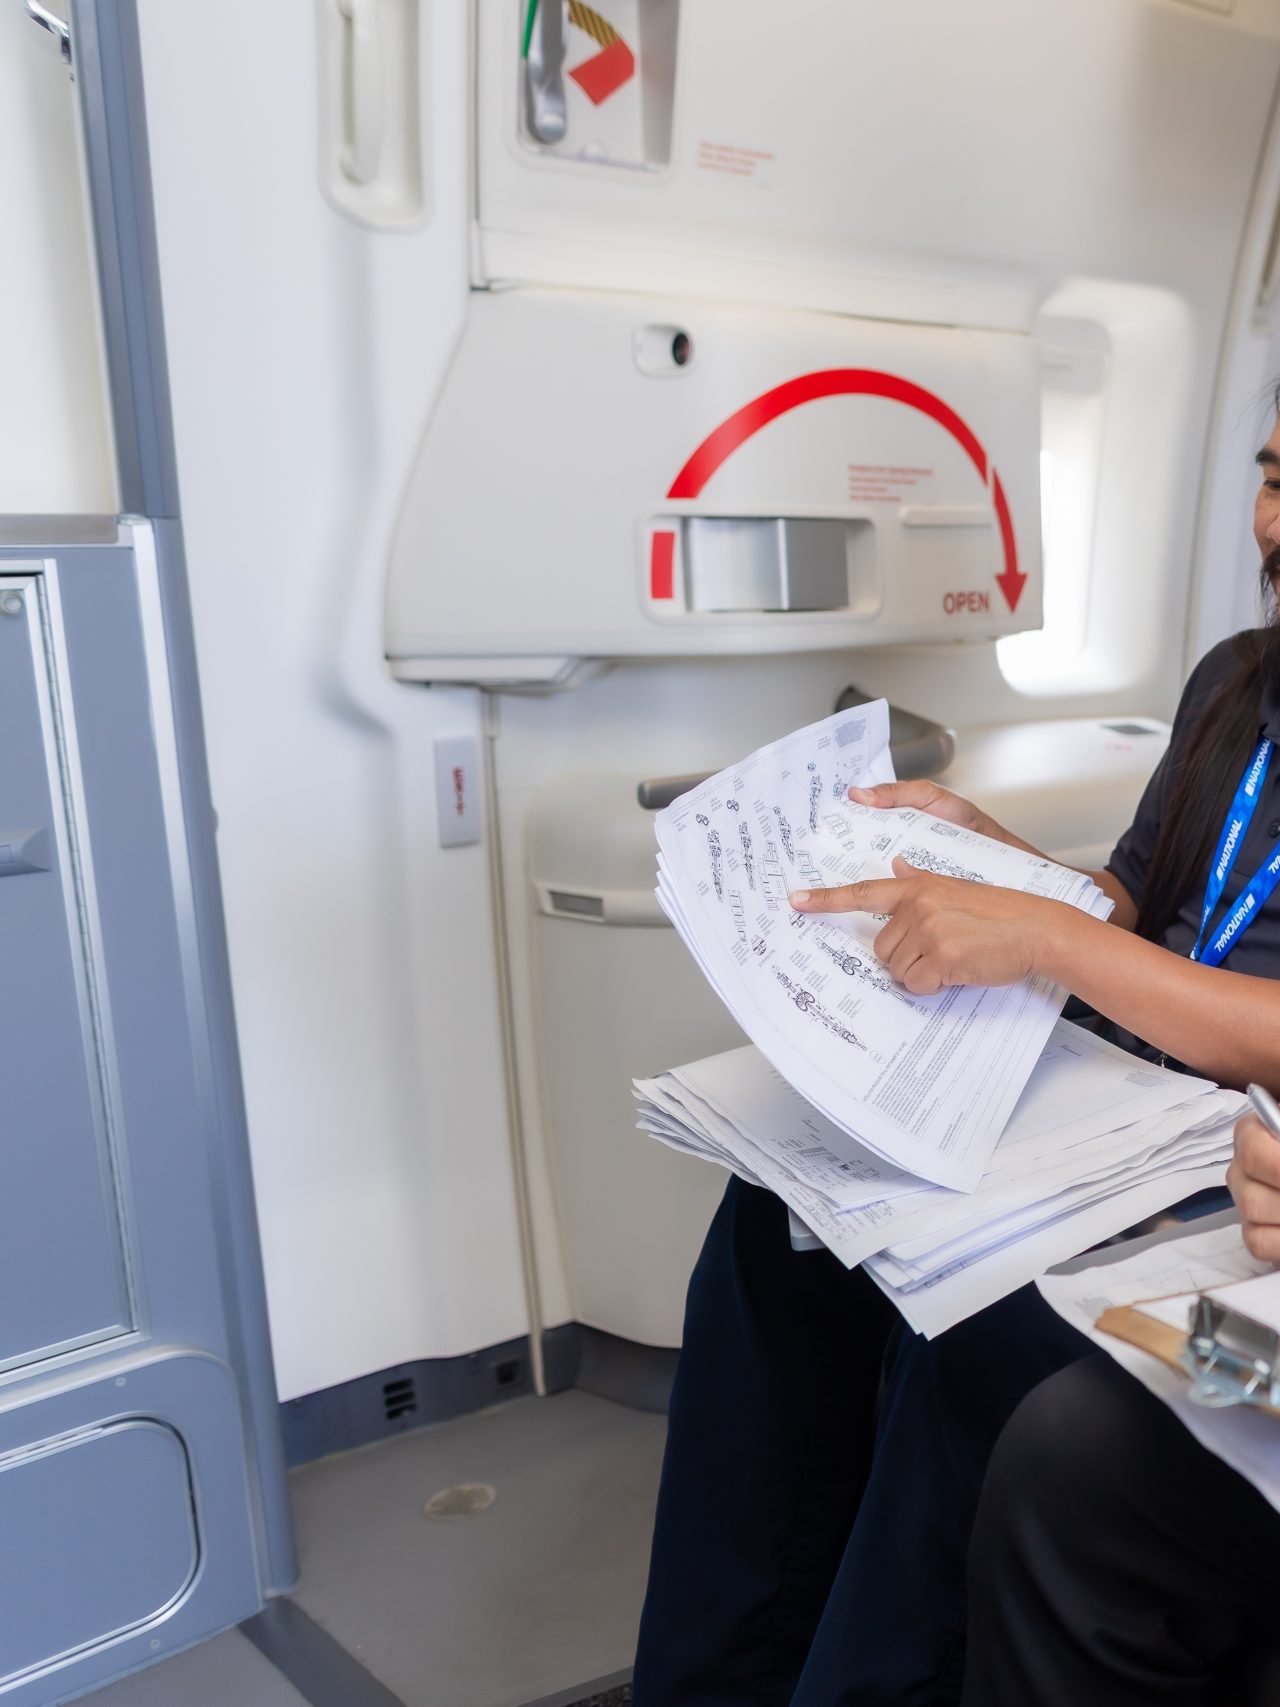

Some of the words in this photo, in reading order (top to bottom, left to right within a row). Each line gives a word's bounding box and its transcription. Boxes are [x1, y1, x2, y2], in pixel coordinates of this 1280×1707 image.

[943, 591, 990, 615] OPEN
[1219, 818, 1243, 870] NATIONAL
[1214, 902, 1254, 952] NATIONAL
